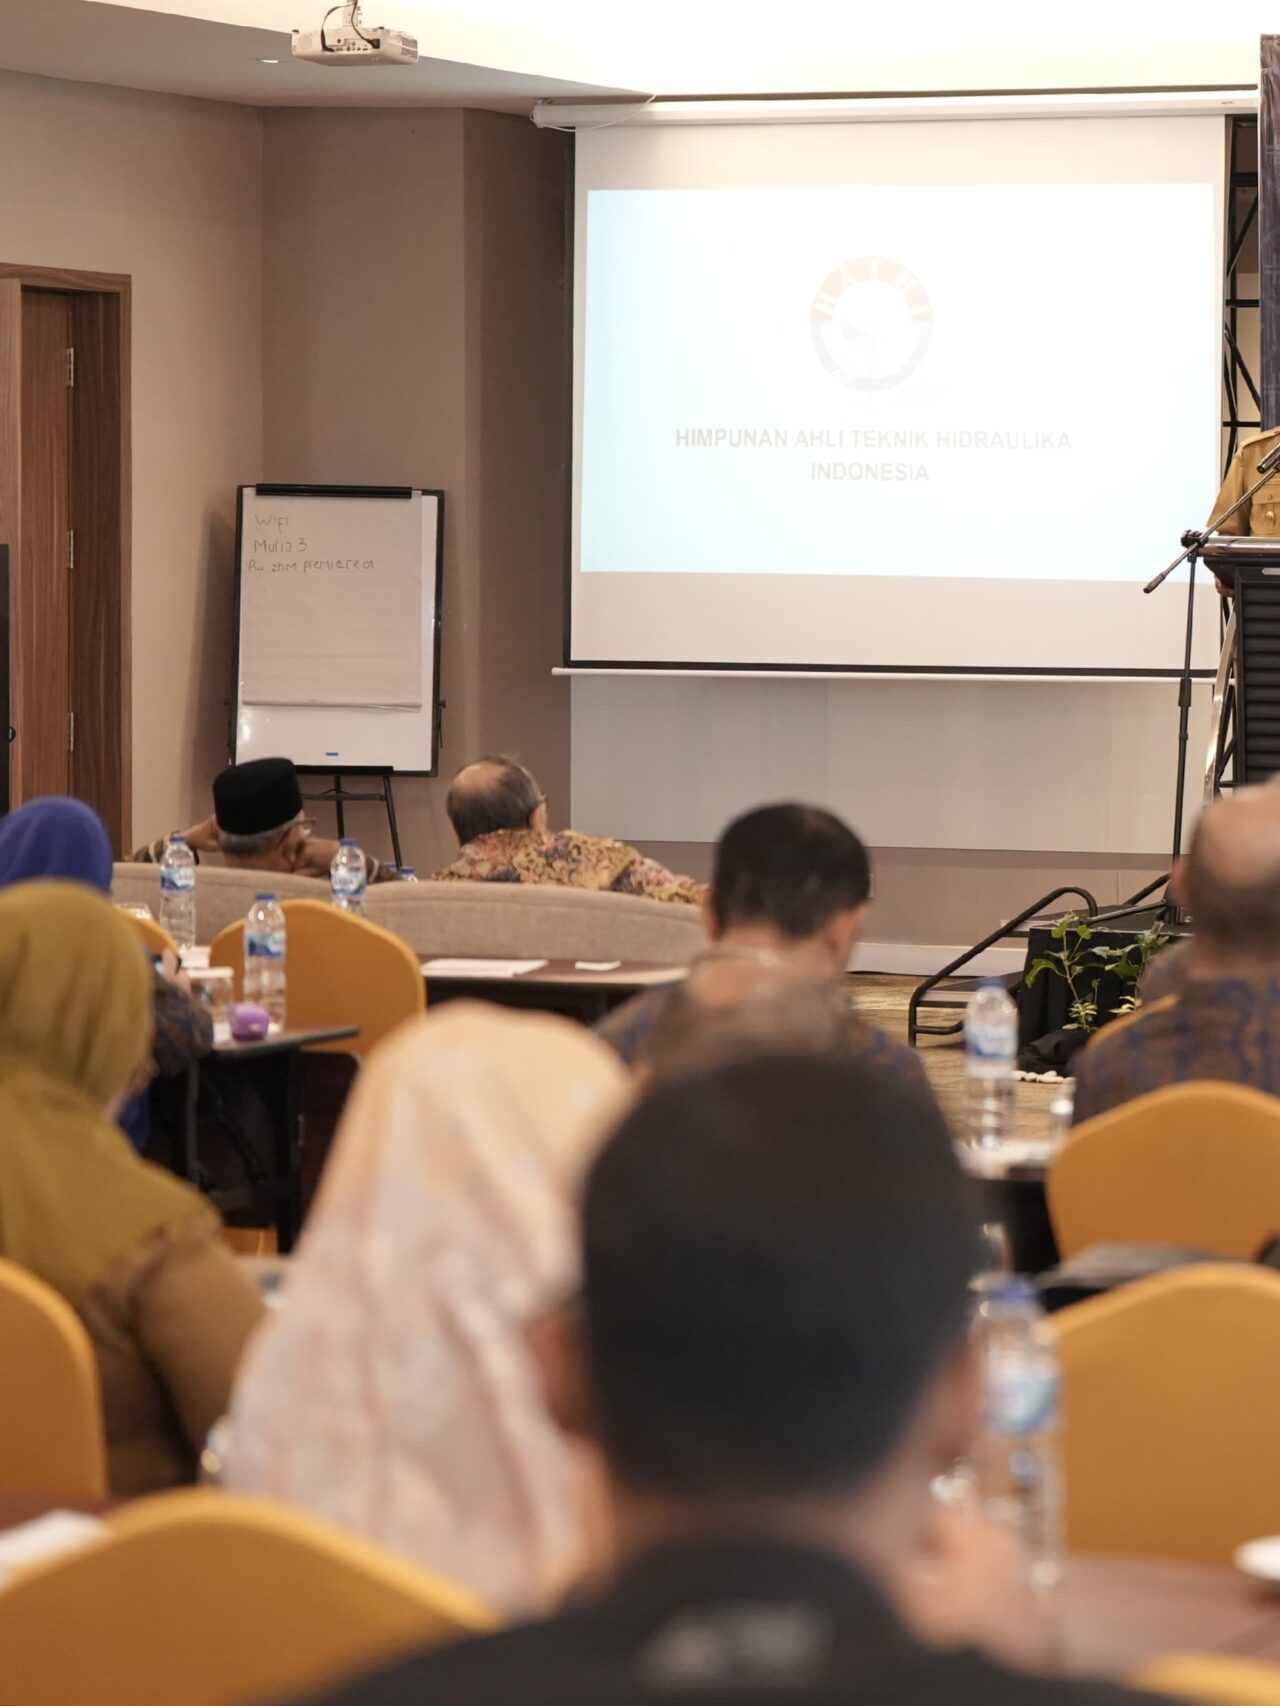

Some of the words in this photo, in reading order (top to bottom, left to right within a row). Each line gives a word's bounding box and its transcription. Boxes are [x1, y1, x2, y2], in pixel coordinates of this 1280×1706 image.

[675, 428, 788, 449] HIMPUNAN
[794, 429, 844, 449] AHLI
[852, 429, 929, 449] TEKNIK
[936, 429, 1072, 450] HIDRAULIKA
[811, 461, 930, 481] INDONESIA
